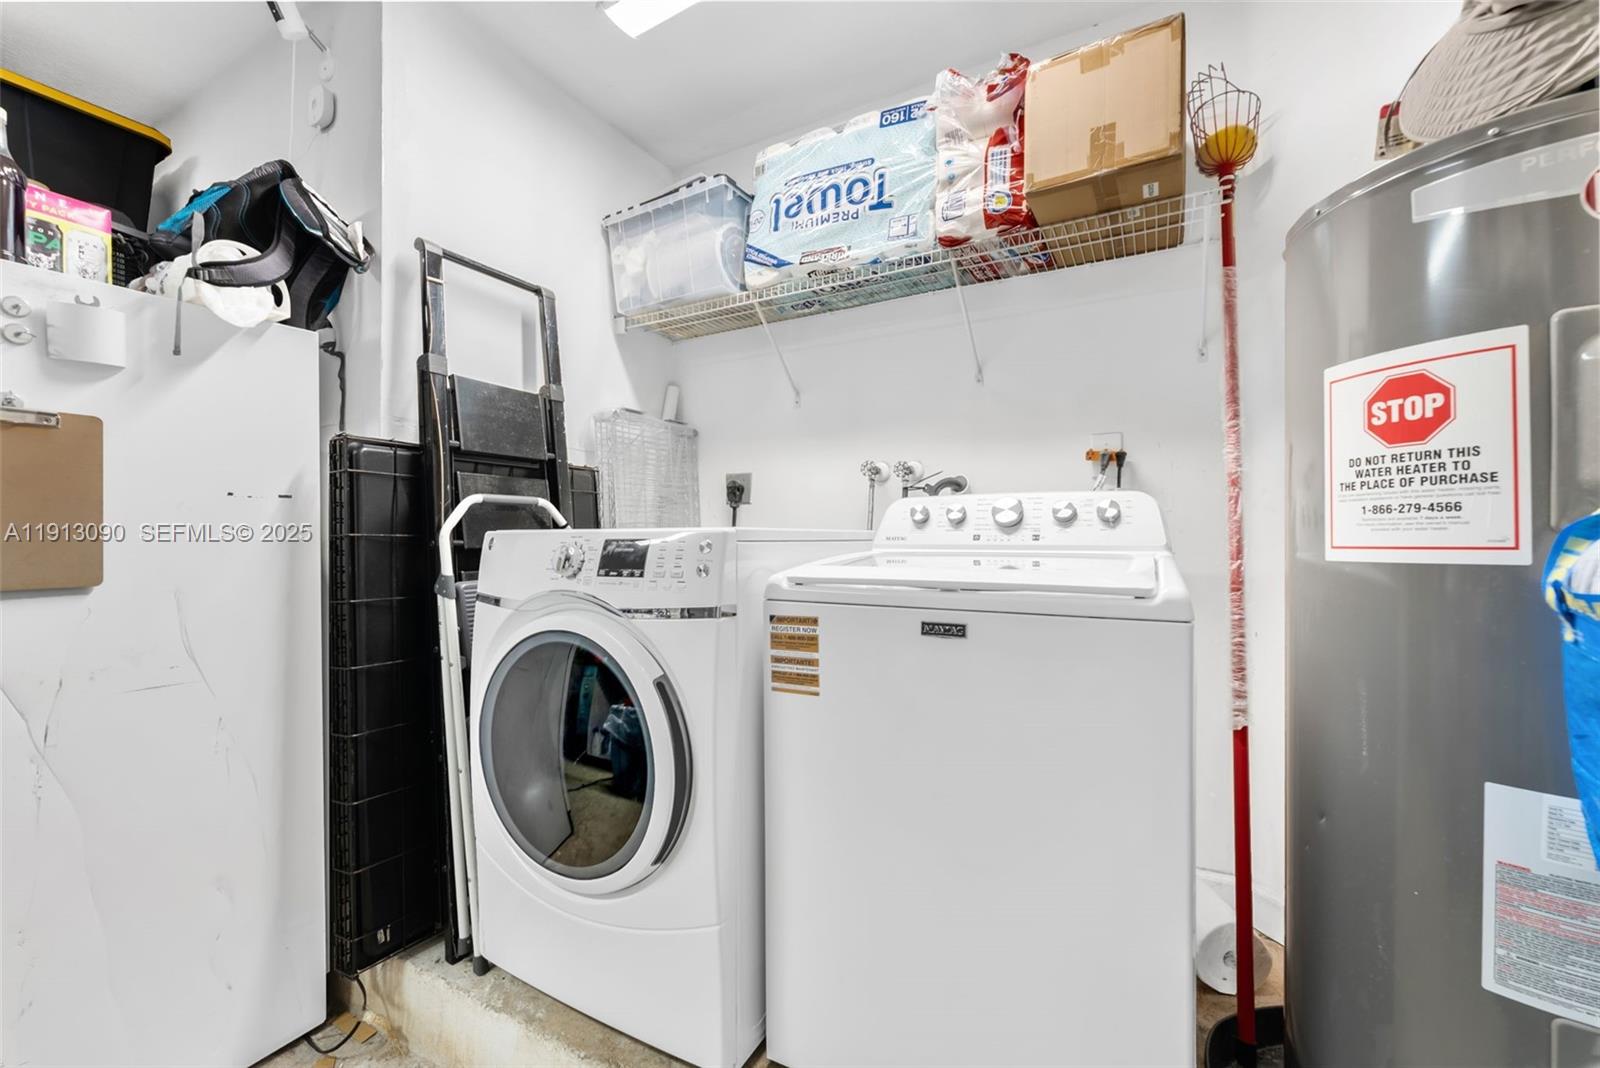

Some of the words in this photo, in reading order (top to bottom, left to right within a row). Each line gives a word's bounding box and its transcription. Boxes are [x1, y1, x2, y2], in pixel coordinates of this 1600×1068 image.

[882, 111, 905, 125] 160
[1520, 142, 1600, 172] PERF
[791, 209, 860, 231] PREMIUM
[1370, 392, 1445, 427] STOP
[1348, 456, 1361, 468] DO
[1365, 454, 1386, 467] NOT
[1391, 449, 1442, 464] RETURN
[1447, 445, 1481, 458] THIS
[1354, 466, 1392, 480] WATER
[1396, 461, 1446, 475] HEATER
[1453, 460, 1471, 472] TO
[1340, 480, 1356, 493] THE
[1360, 477, 1394, 491] PLACE
[1399, 476, 1415, 489] OF
[1420, 471, 1499, 486] PURCHASE
[1361, 501, 1463, 516] 1-866-279-4566
[771, 625, 801, 633] REGISTER
